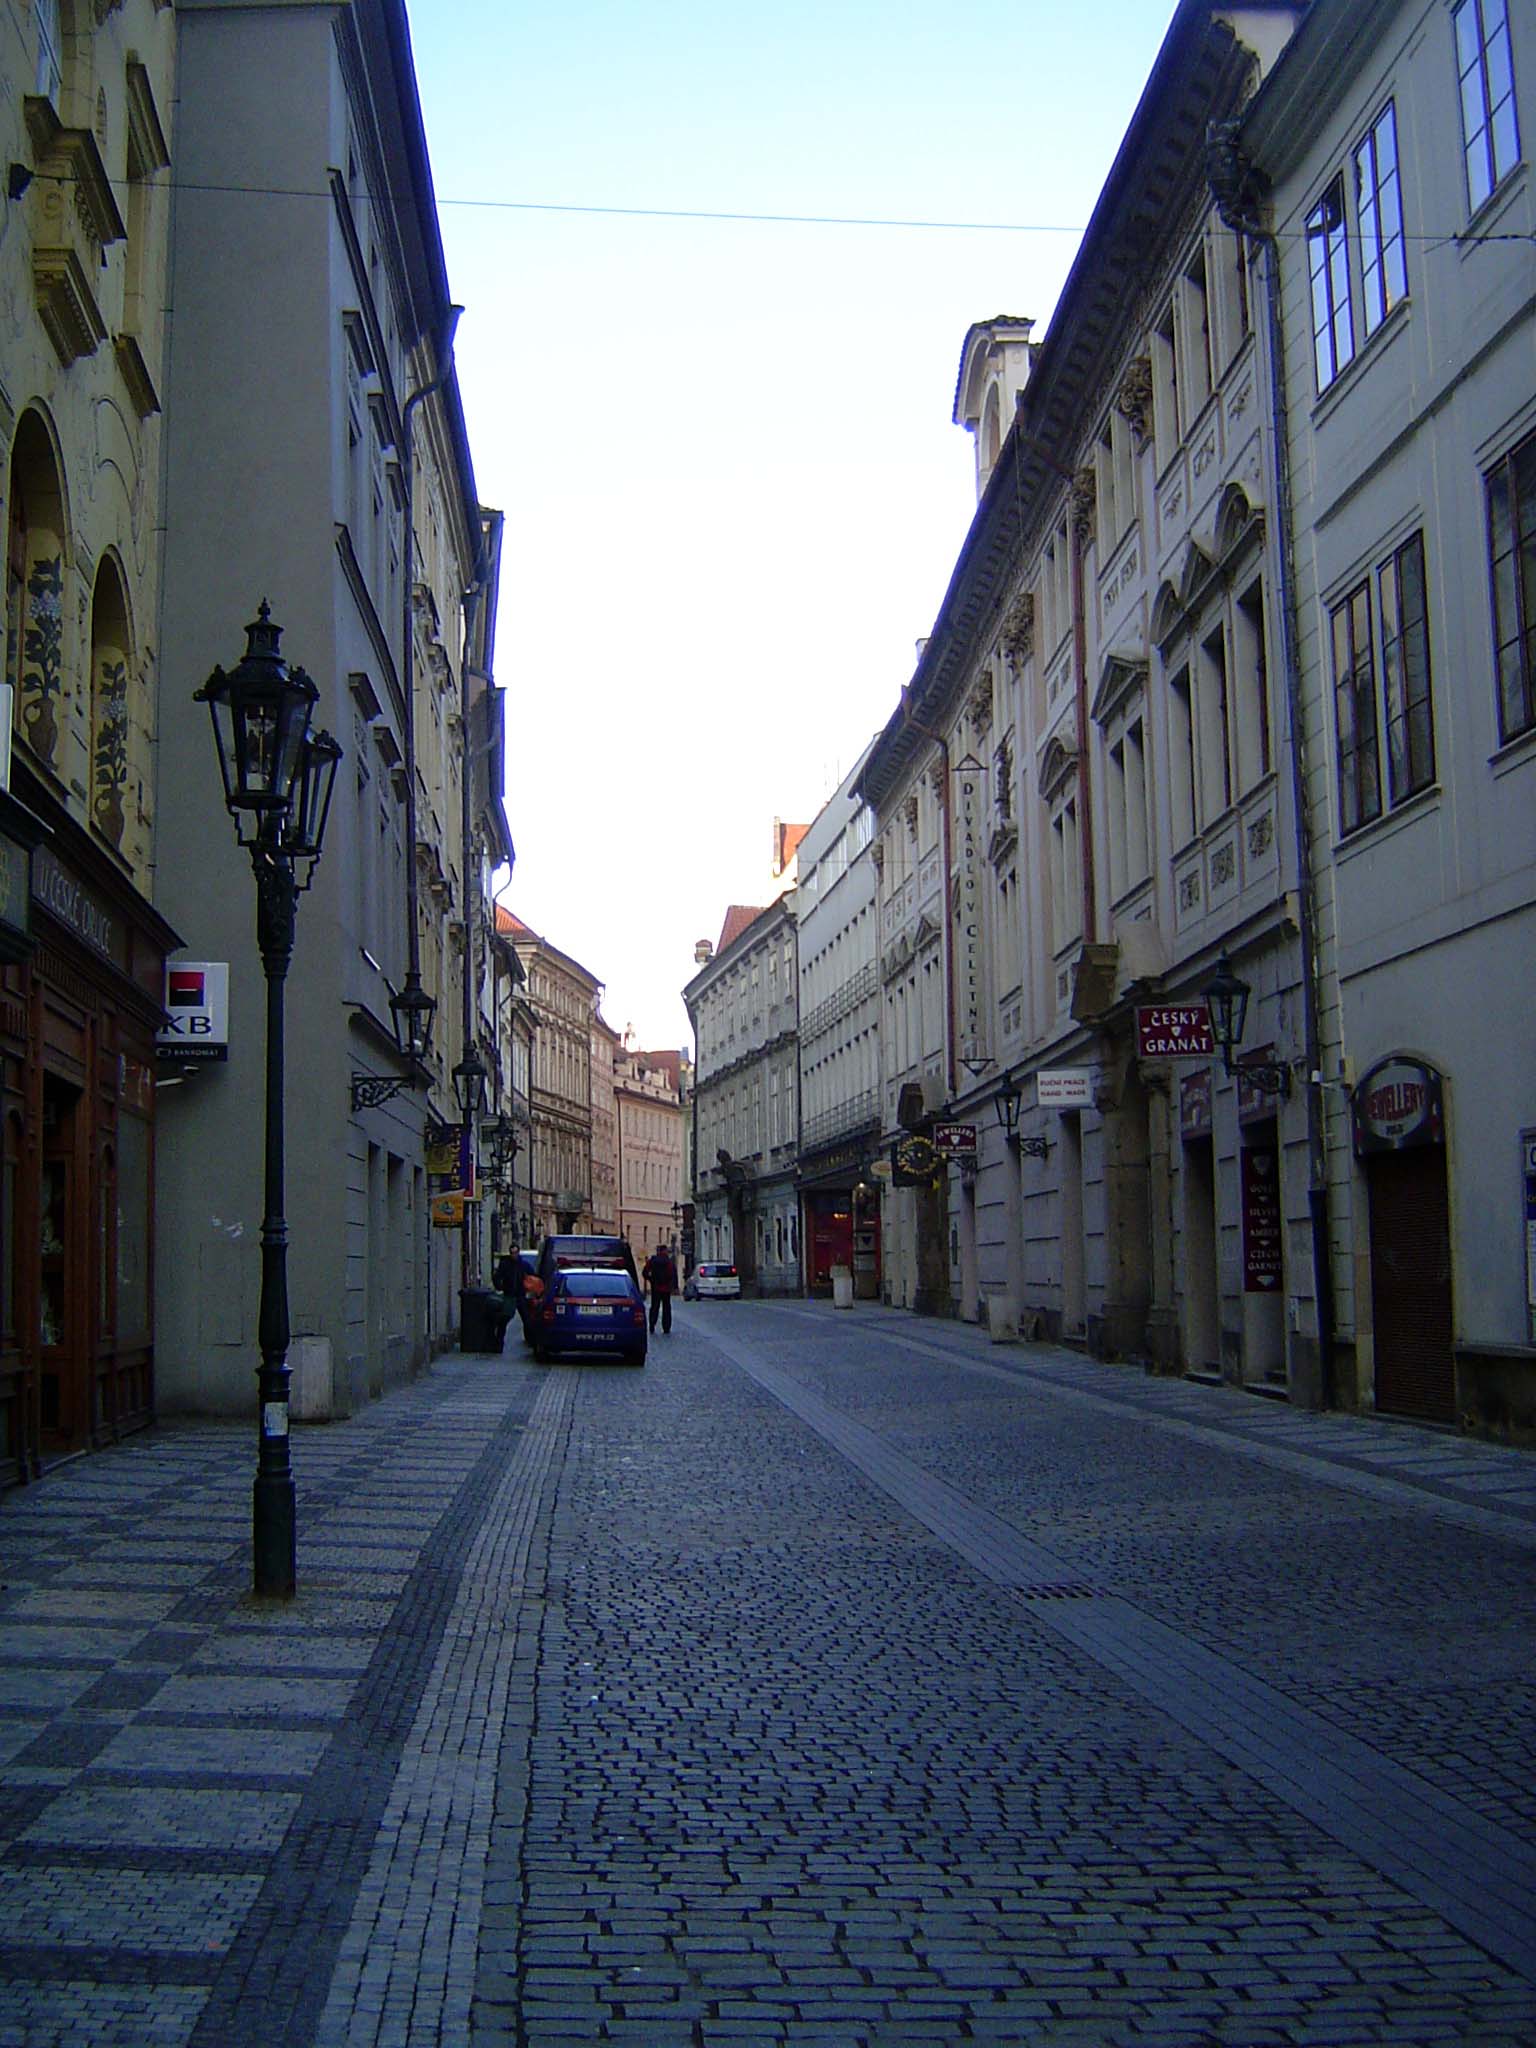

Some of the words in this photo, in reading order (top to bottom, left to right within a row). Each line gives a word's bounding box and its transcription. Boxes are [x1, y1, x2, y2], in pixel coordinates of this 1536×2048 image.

[963, 782, 975, 890] DIVADLO
[967, 902, 975, 912] V
[159, 1015, 212, 1034] KB
[1150, 1009, 1199, 1026] ČESKÝ
[1145, 1034, 1209, 1053] GRANÁT
